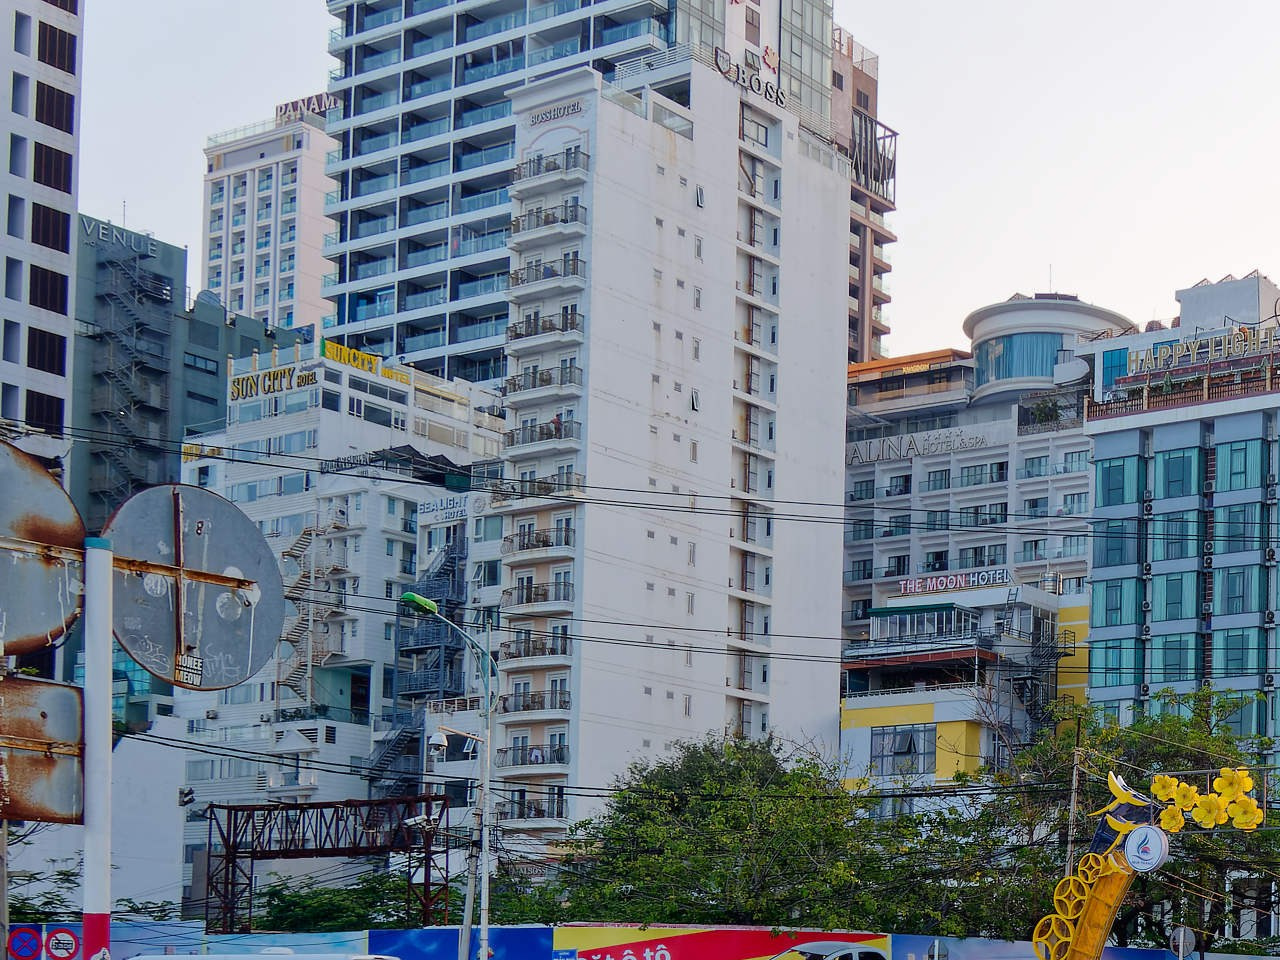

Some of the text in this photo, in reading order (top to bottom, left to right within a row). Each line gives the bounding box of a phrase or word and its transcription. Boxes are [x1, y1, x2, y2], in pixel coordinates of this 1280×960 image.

[736, 64, 786, 109] BOSS
[530, 101, 582, 126] BOSS HOTEL
[82, 217, 157, 258] VENUE
[325, 340, 411, 385] SUN CITY HOTEL
[1127, 340, 1201, 374] HAPPY
[1208, 325, 1277, 360] LIGHT
[231, 367, 318, 401] SUN CITY HOTEL
[418, 495, 469, 514] SEA LIGHT
[445, 509, 468, 520] HOTEL
[899, 568, 1011, 594] THE MOON HOTEL
[175, 670, 202, 687] MEOW
